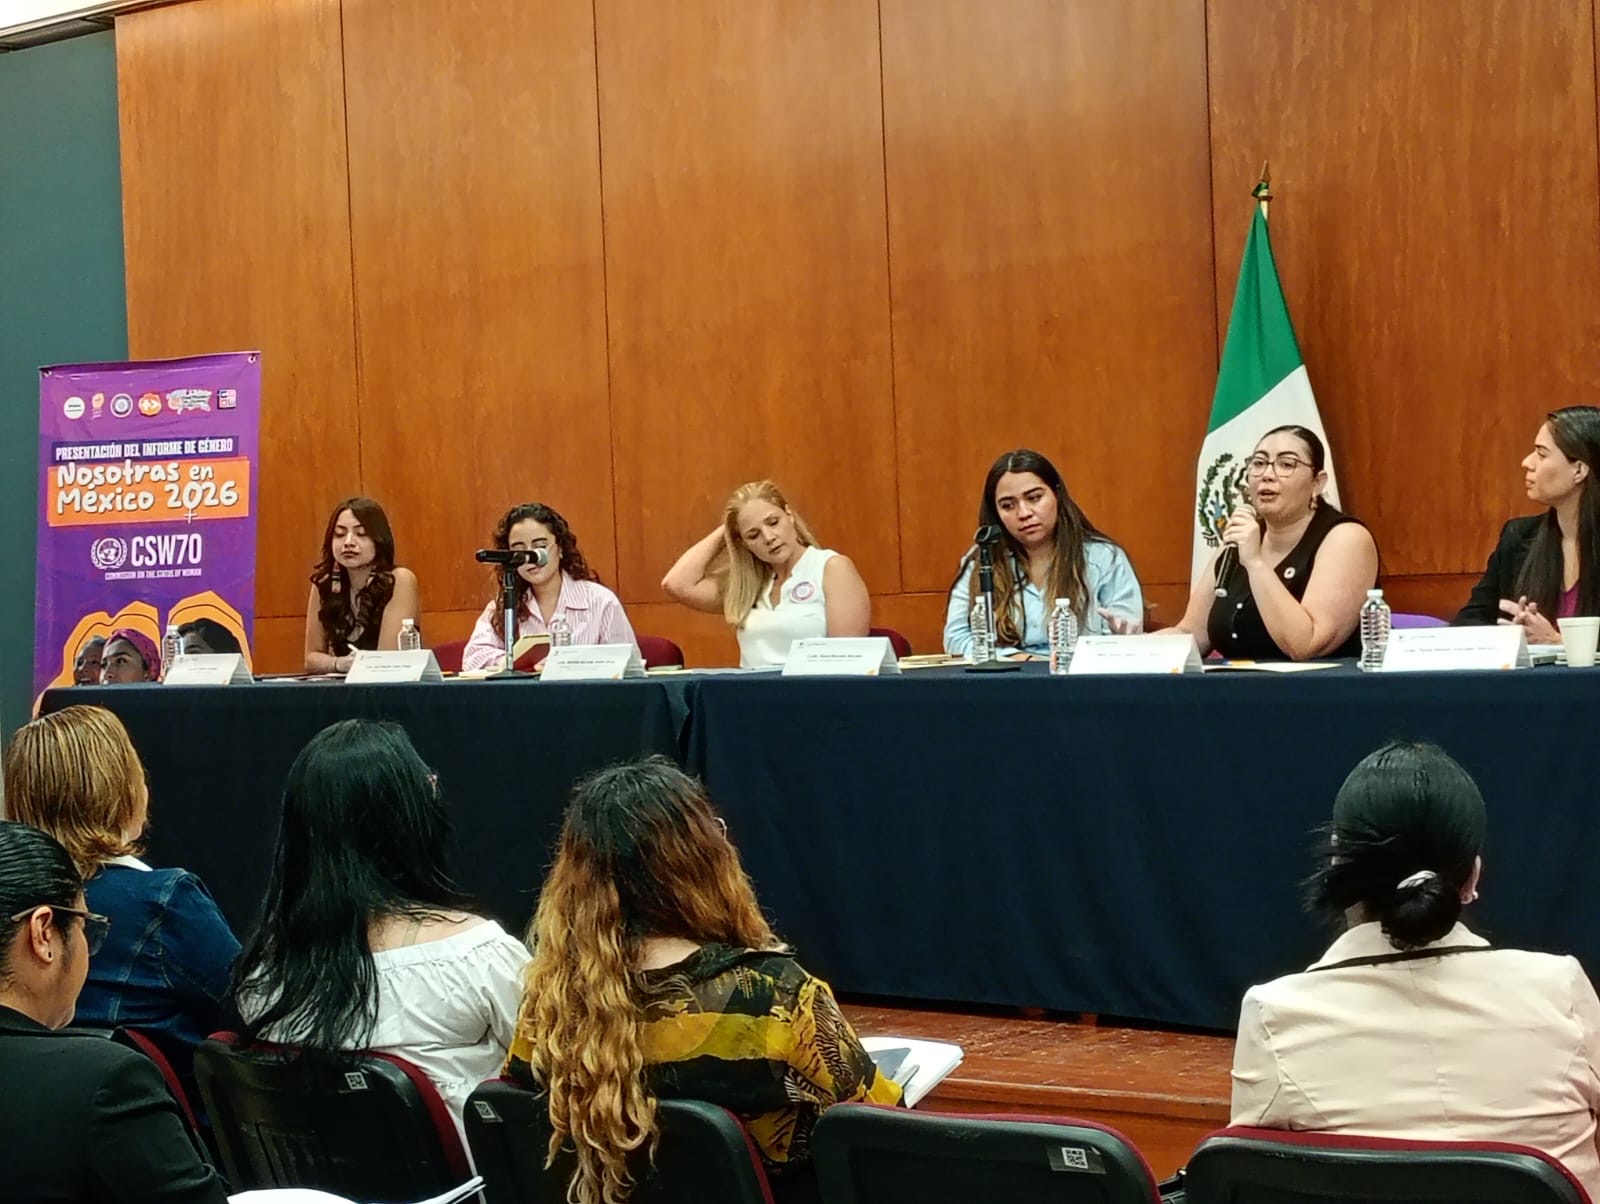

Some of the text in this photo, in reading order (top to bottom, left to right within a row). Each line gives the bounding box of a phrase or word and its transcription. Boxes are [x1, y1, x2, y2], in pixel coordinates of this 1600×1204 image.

[55, 437, 233, 461] PRESENTACIÓN DEL INFORME DE GÉNERO
[57, 459, 214, 488] Nosotras en
[57, 480, 239, 515] México 2026
[131, 533, 202, 567] CSW70
